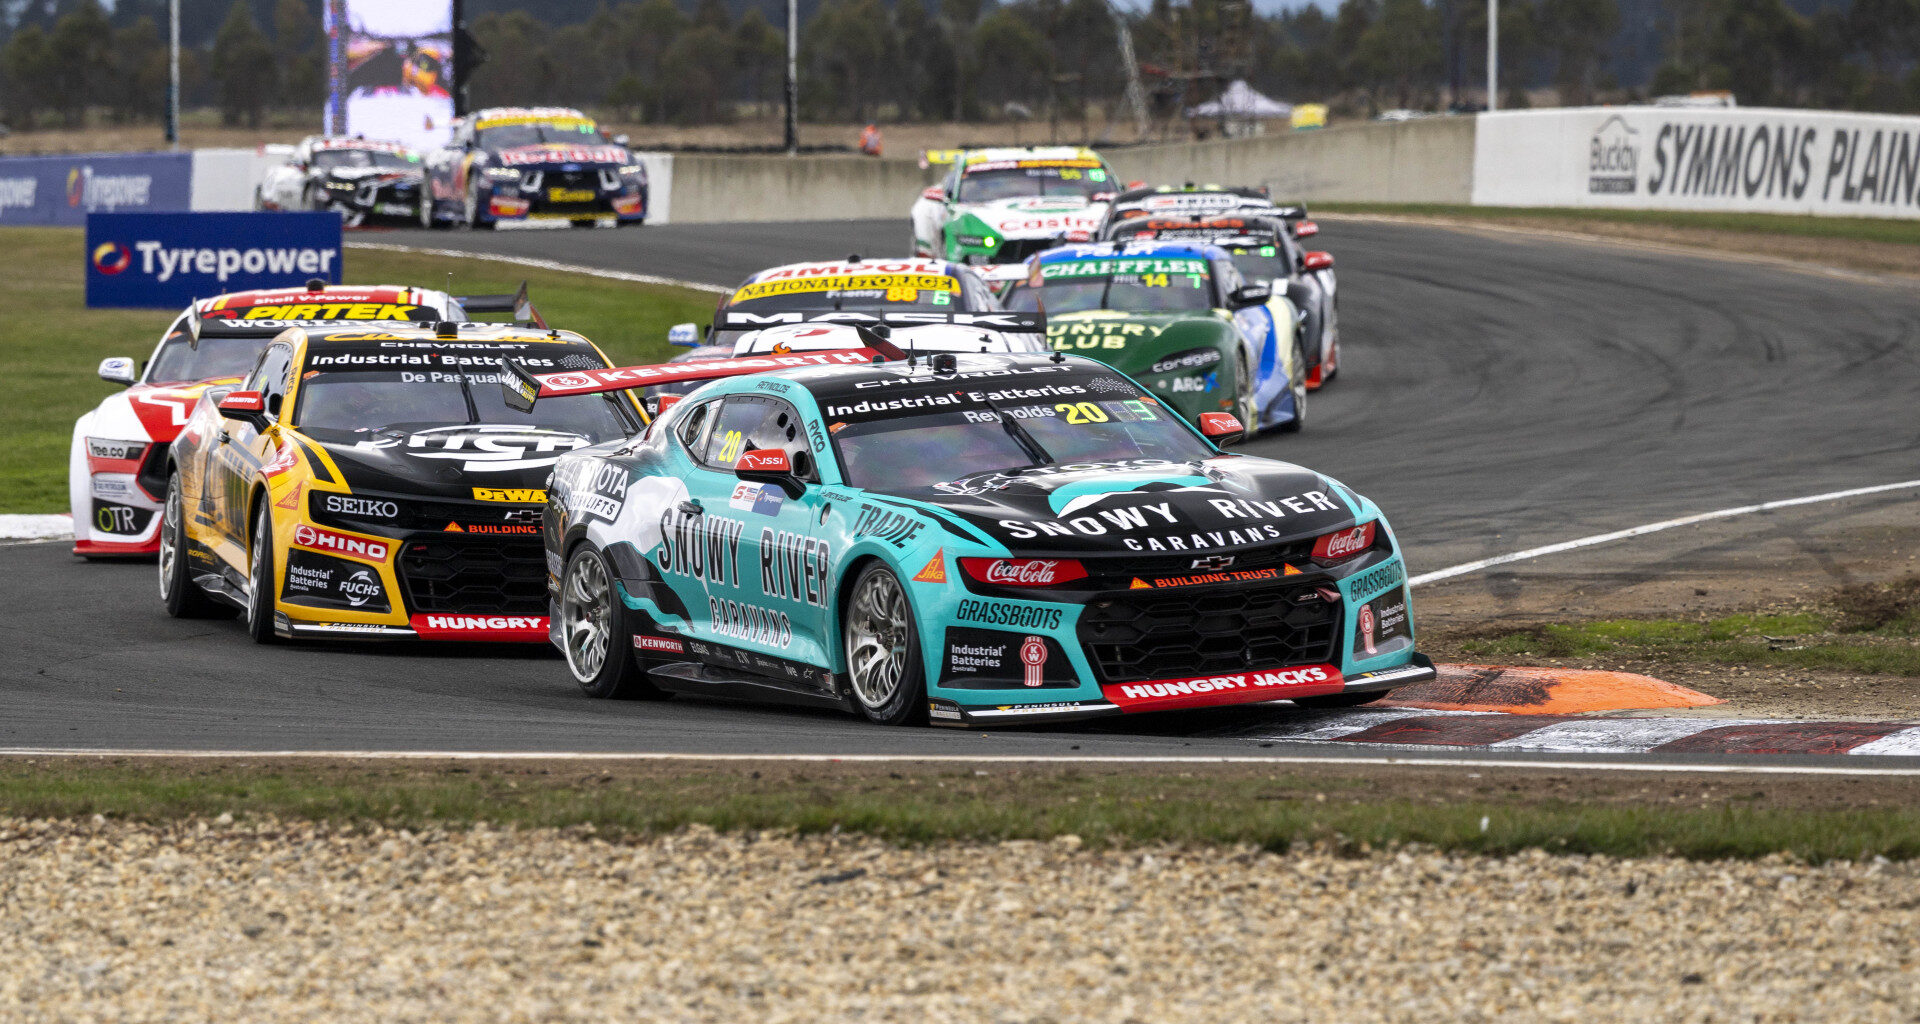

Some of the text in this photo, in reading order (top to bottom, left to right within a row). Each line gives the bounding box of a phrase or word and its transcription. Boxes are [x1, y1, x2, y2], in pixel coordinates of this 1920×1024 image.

[1648, 123, 1816, 199] SYMMONS
[81, 166, 152, 213] Tyrepower
[135, 241, 336, 282] Tyrepower
[1041, 260, 1205, 277] CHAEFFLER
[763, 264, 940, 280] AMPOL
[1142, 273, 1169, 287] 14
[1187, 273, 1201, 288] 7
[741, 275, 954, 299] NATIONAL STORAGE
[886, 286, 918, 301] 88
[933, 291, 950, 305] 6
[254, 294, 370, 304] Shell V-Power
[243, 303, 418, 320] PIRTEK
[726, 312, 1018, 326] MACK
[1047, 323, 1172, 337] UNTRY
[1053, 335, 1126, 349] LUB
[311, 354, 554, 367] Industrial Batteries
[598, 352, 870, 382] KENWORTH
[1152, 350, 1221, 373] coregas
[401, 371, 502, 386] De Pasqual
[502, 370, 522, 393] JAX
[854, 365, 1073, 389] CHEVROLET
[827, 384, 1087, 417] Industrial Batteries
[1054, 402, 1109, 425] 20
[808, 419, 825, 453] RYCO
[718, 430, 742, 463] 20
[760, 457, 783, 465] JSSI
[474, 489, 548, 503] DEWA
[327, 495, 398, 518] SEIKO
[998, 490, 1340, 539] SNOWY RIVER
[98, 506, 137, 532] OTR
[468, 524, 537, 534] BUILDING
[853, 503, 926, 549] TRADIE
[317, 533, 386, 559] HINO
[1123, 525, 1281, 552] CARAVANS
[1327, 523, 1368, 557] Coca-Cola
[658, 506, 831, 611] SNOWY RIVER
[290, 565, 330, 580] Industrial
[918, 559, 944, 579] Sika
[986, 560, 1059, 583] Coca-Cola
[1156, 568, 1278, 588] BUILDING TRUST
[289, 574, 328, 589] Batteries
[339, 581, 380, 596] FUCHS
[427, 616, 542, 629] HUNGRY
[708, 594, 793, 650] CARAVANS
[641, 637, 683, 651] KENWORTH
[951, 644, 1002, 657] Industrial
[951, 655, 1001, 667] Batteries
[951, 665, 977, 673] Australia
[1121, 667, 1328, 699] HUNGRY JACK'S
[1014, 701, 1081, 709] PENINSULA
